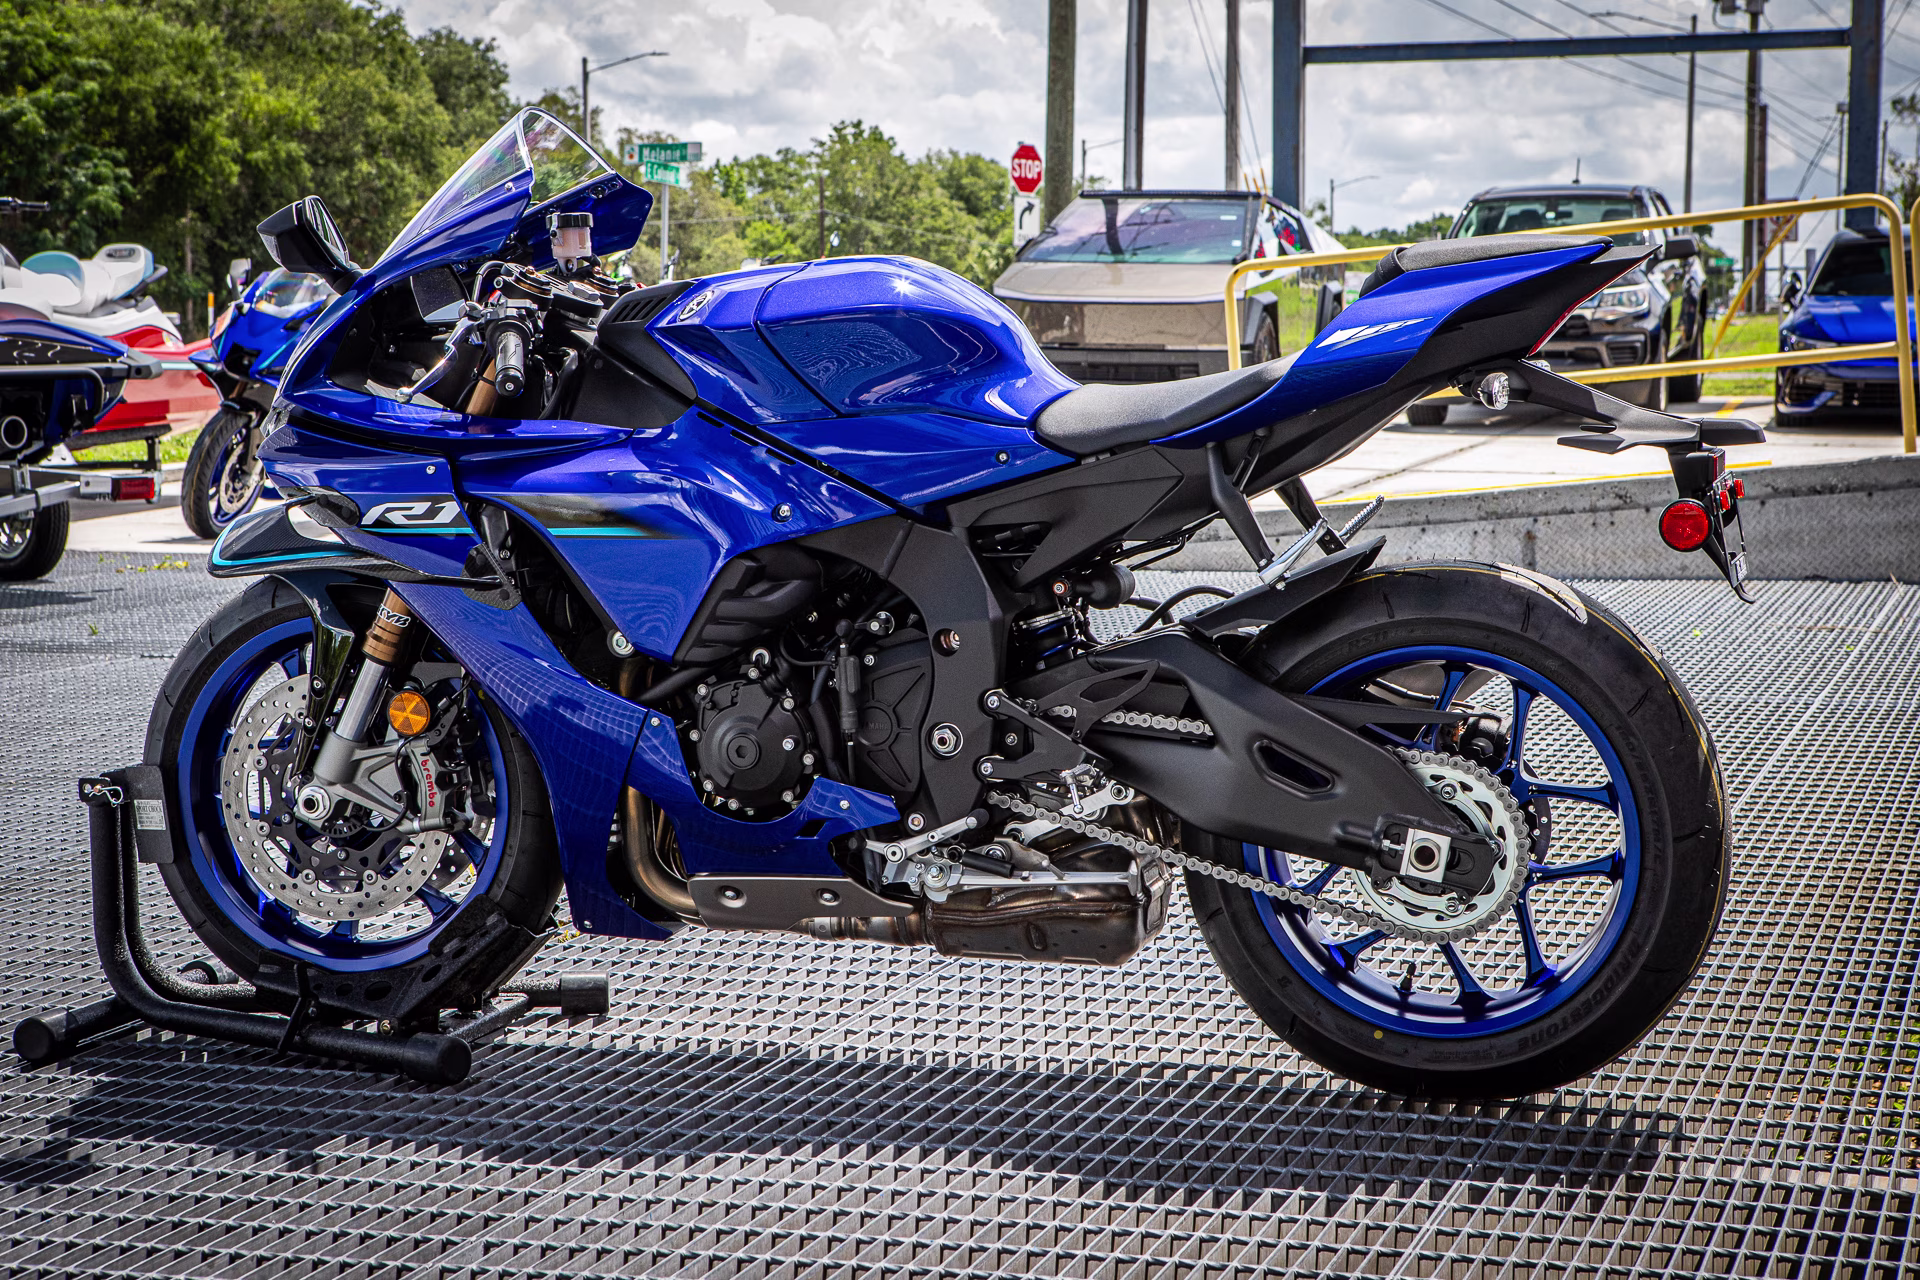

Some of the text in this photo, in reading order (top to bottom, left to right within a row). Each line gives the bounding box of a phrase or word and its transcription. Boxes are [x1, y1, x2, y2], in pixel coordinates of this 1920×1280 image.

[642, 146, 681, 161] Melanie
[1012, 158, 1041, 179] STOP
[361, 501, 460, 525] R1
[421, 759, 437, 807] brembo
